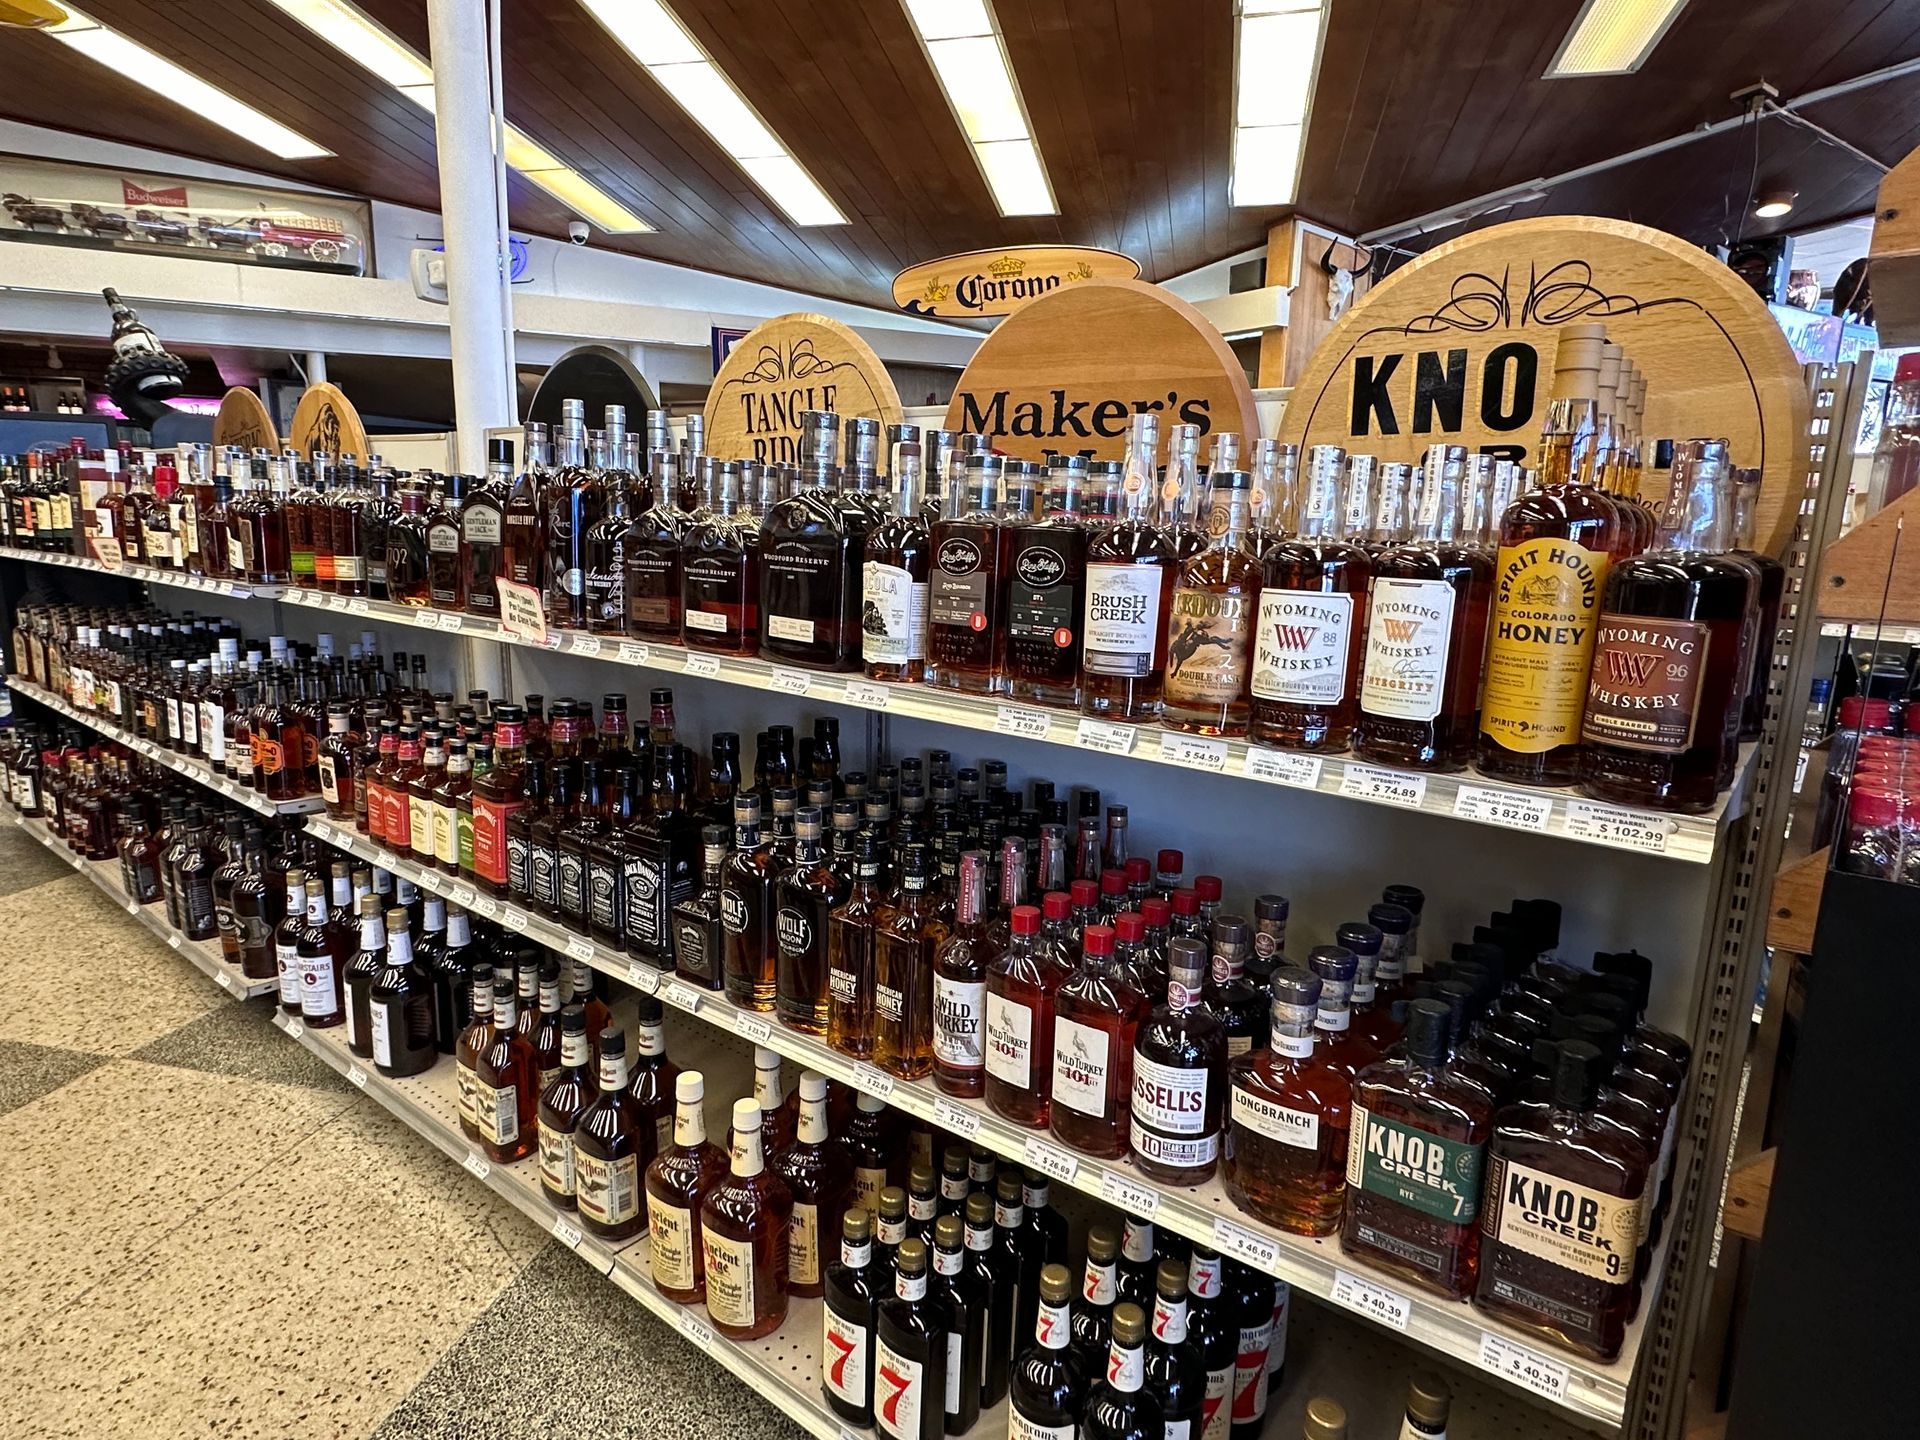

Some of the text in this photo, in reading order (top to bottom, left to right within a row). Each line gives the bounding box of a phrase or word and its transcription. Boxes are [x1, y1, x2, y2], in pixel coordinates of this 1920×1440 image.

[127, 188, 185, 208] Budweiser
[1350, 341, 1539, 437] KNO
[958, 391, 1211, 438] Maker's
[753, 435, 803, 465] RID
[466, 517, 497, 526] GENTLEMAN
[474, 525, 488, 534] JACK
[764, 553, 830, 565] WOODFORD RESERVE
[1499, 548, 1595, 609] SPIRIT HOUND
[1091, 592, 1148, 609] BRUSH
[1090, 607, 1146, 624] CREEK
[1262, 603, 1341, 625] WYOMING
[1375, 602, 1441, 620] WYOMING
[1511, 609, 1576, 622] COLORADO
[1322, 632, 1337, 644] 88
[1498, 621, 1586, 645] HONEY
[1597, 628, 1694, 655] WYOMING
[1372, 637, 1433, 657] WHISKEY
[1259, 646, 1336, 670] WHISKEY
[1494, 654, 1527, 663] STRAIGHT
[1179, 670, 1212, 682] DOUBLE
[1666, 664, 1689, 678] 96
[1365, 675, 1434, 693] INTEGRITY
[1590, 678, 1680, 709] WHISKEY
[1491, 716, 1566, 733] SPIRIT HOUND
[1595, 716, 1652, 731] SINGLE BARREL
[1603, 728, 1681, 744] BOURBON WHISKEY
[1185, 750, 1220, 763] $ 54.59
[1365, 769, 1421, 782] WYOMING WHISKEY
[1370, 777, 1400, 785] INTEGRITY
[1373, 784, 1417, 798] $ 74.89
[1481, 791, 1531, 804] SPIRIT HOUNDS
[1466, 795, 1544, 813] COLORADO HONEY MALT
[1490, 806, 1540, 823] $ 82.09
[1591, 815, 1647, 829] SINGLE BARREL
[1593, 807, 1628, 818] WYOMING
[1630, 813, 1664, 823] WHISKEY
[1599, 824, 1664, 842] $ 102.99
[624, 860, 660, 888] JACK DANIEL'S
[904, 880, 925, 890] HONEY
[721, 896, 744, 917] WOLF
[723, 911, 740, 924] MOON
[779, 911, 807, 938] WOLF
[781, 933, 802, 945] MOON
[829, 975, 857, 995] HONEY
[831, 967, 857, 983] AMERICAN
[877, 983, 903, 999] AMERICAN
[876, 991, 903, 1013] HONEY
[937, 996, 971, 1018] WILD
[988, 1023, 1003, 1040] WILD
[1003, 1031, 1028, 1050] TURKEY
[994, 1040, 1016, 1057] 101
[1056, 1050, 1103, 1077] WILD TURKEY
[1065, 1068, 1090, 1087] 101
[1133, 1069, 1202, 1112] USSELL'S
[1235, 1092, 1310, 1128] LONGBRANCH
[956, 1118, 975, 1130] 24.29
[1143, 1136, 1159, 1156] 10
[1163, 1142, 1183, 1152] YEARS
[1368, 1122, 1445, 1176] KNOB
[584, 1159, 607, 1178] HIGH
[1043, 1156, 1070, 1175] $ 26.69
[1380, 1158, 1457, 1194] CREEK
[1122, 1190, 1153, 1208] $ 47.19
[1400, 1188, 1415, 1200] RYE
[1509, 1173, 1599, 1232] KNOB
[1453, 1194, 1464, 1216] 7
[652, 1220, 671, 1239] Age
[1523, 1211, 1613, 1252] CREEK
[703, 1238, 740, 1266] Ancient
[1238, 1240, 1273, 1260] $ 46.69
[1507, 1223, 1605, 1263] KENTUCKY STRAIGHT BOURBON
[709, 1255, 730, 1275] Age
[1560, 1251, 1593, 1266] WHISKEY
[1606, 1254, 1620, 1276] 9
[1085, 1272, 1100, 1300] 7
[1196, 1271, 1213, 1295] 7
[1362, 1293, 1402, 1318] $ 40.39
[827, 1311, 855, 1335] Seagram's
[1040, 1317, 1054, 1343] 7
[1154, 1310, 1171, 1338] 7
[826, 1328, 856, 1390] 7
[880, 1344, 910, 1371] Seagram's
[1110, 1354, 1124, 1383] 7
[1512, 1359, 1559, 1387] $ 40.39
[879, 1364, 912, 1427] 7
[1011, 1408, 1058, 1440] Seagram's
